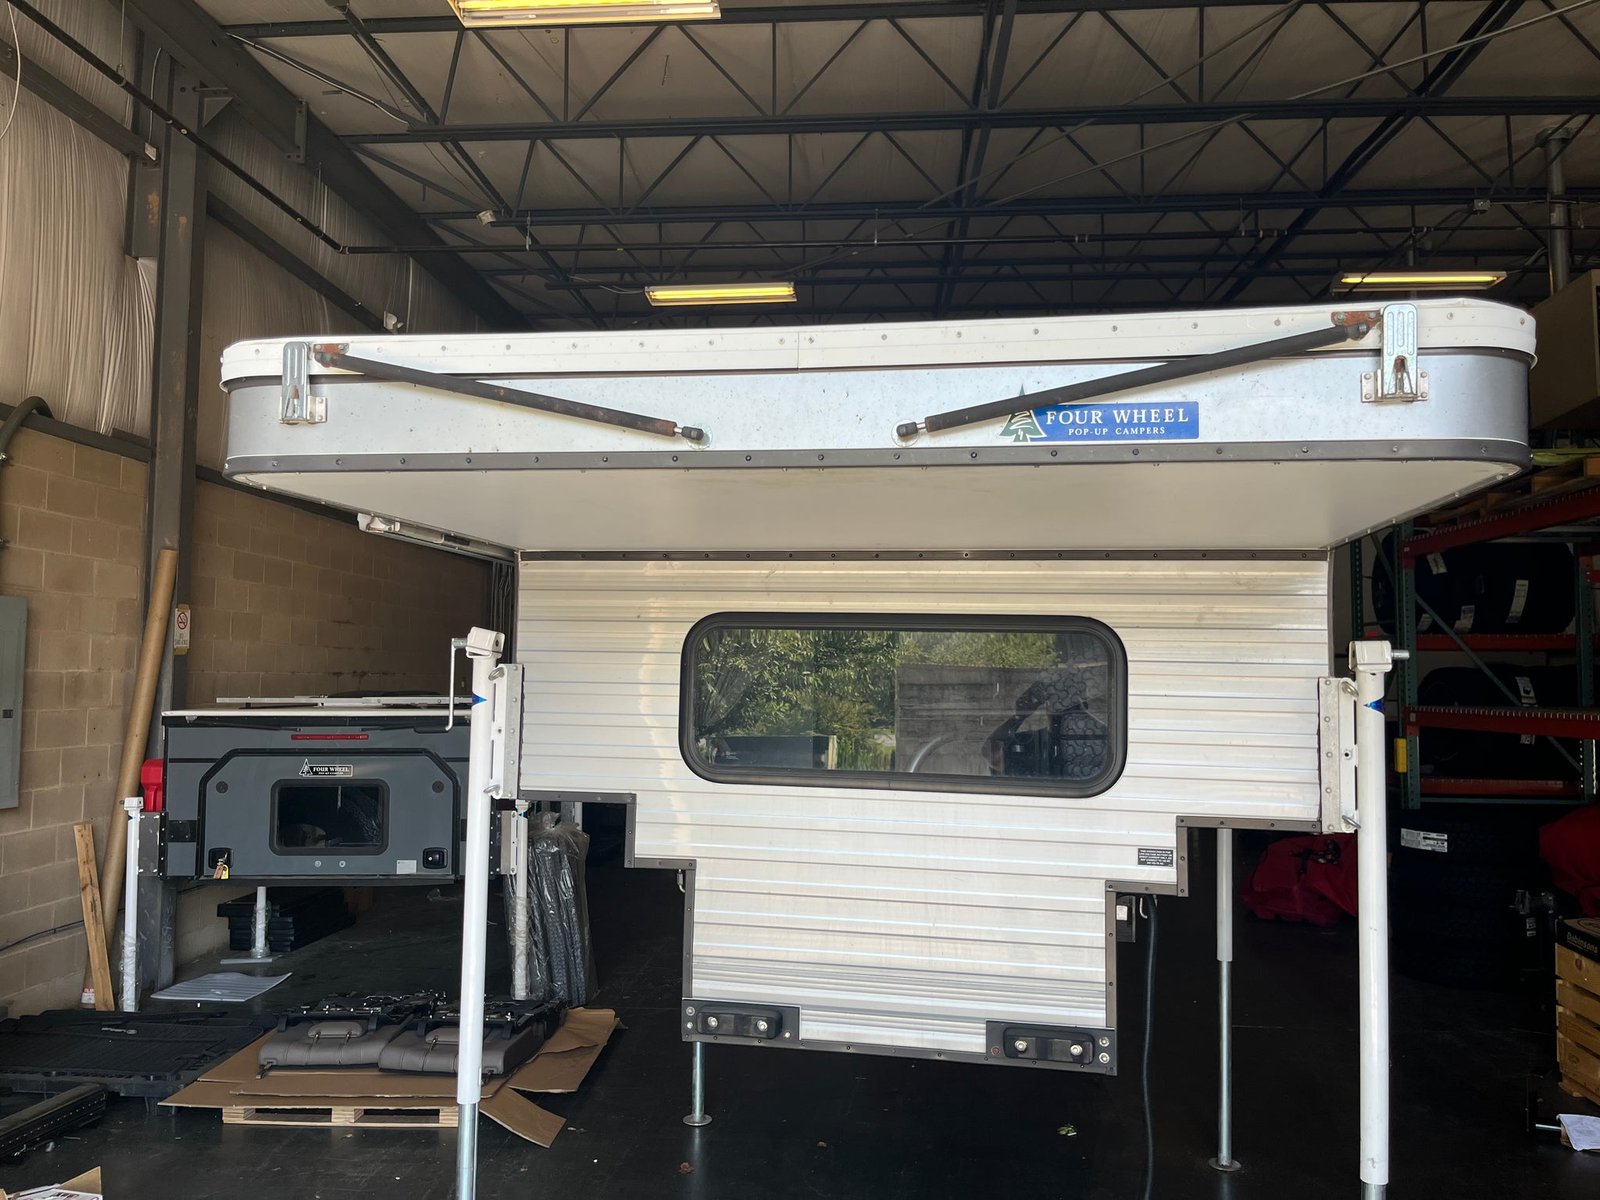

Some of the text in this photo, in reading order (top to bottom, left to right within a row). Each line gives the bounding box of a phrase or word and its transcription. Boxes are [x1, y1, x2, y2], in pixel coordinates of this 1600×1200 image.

[1045, 408, 1189, 425] FOUR WHEEL
[1068, 426, 1166, 436] POP-UP CAMPERS
